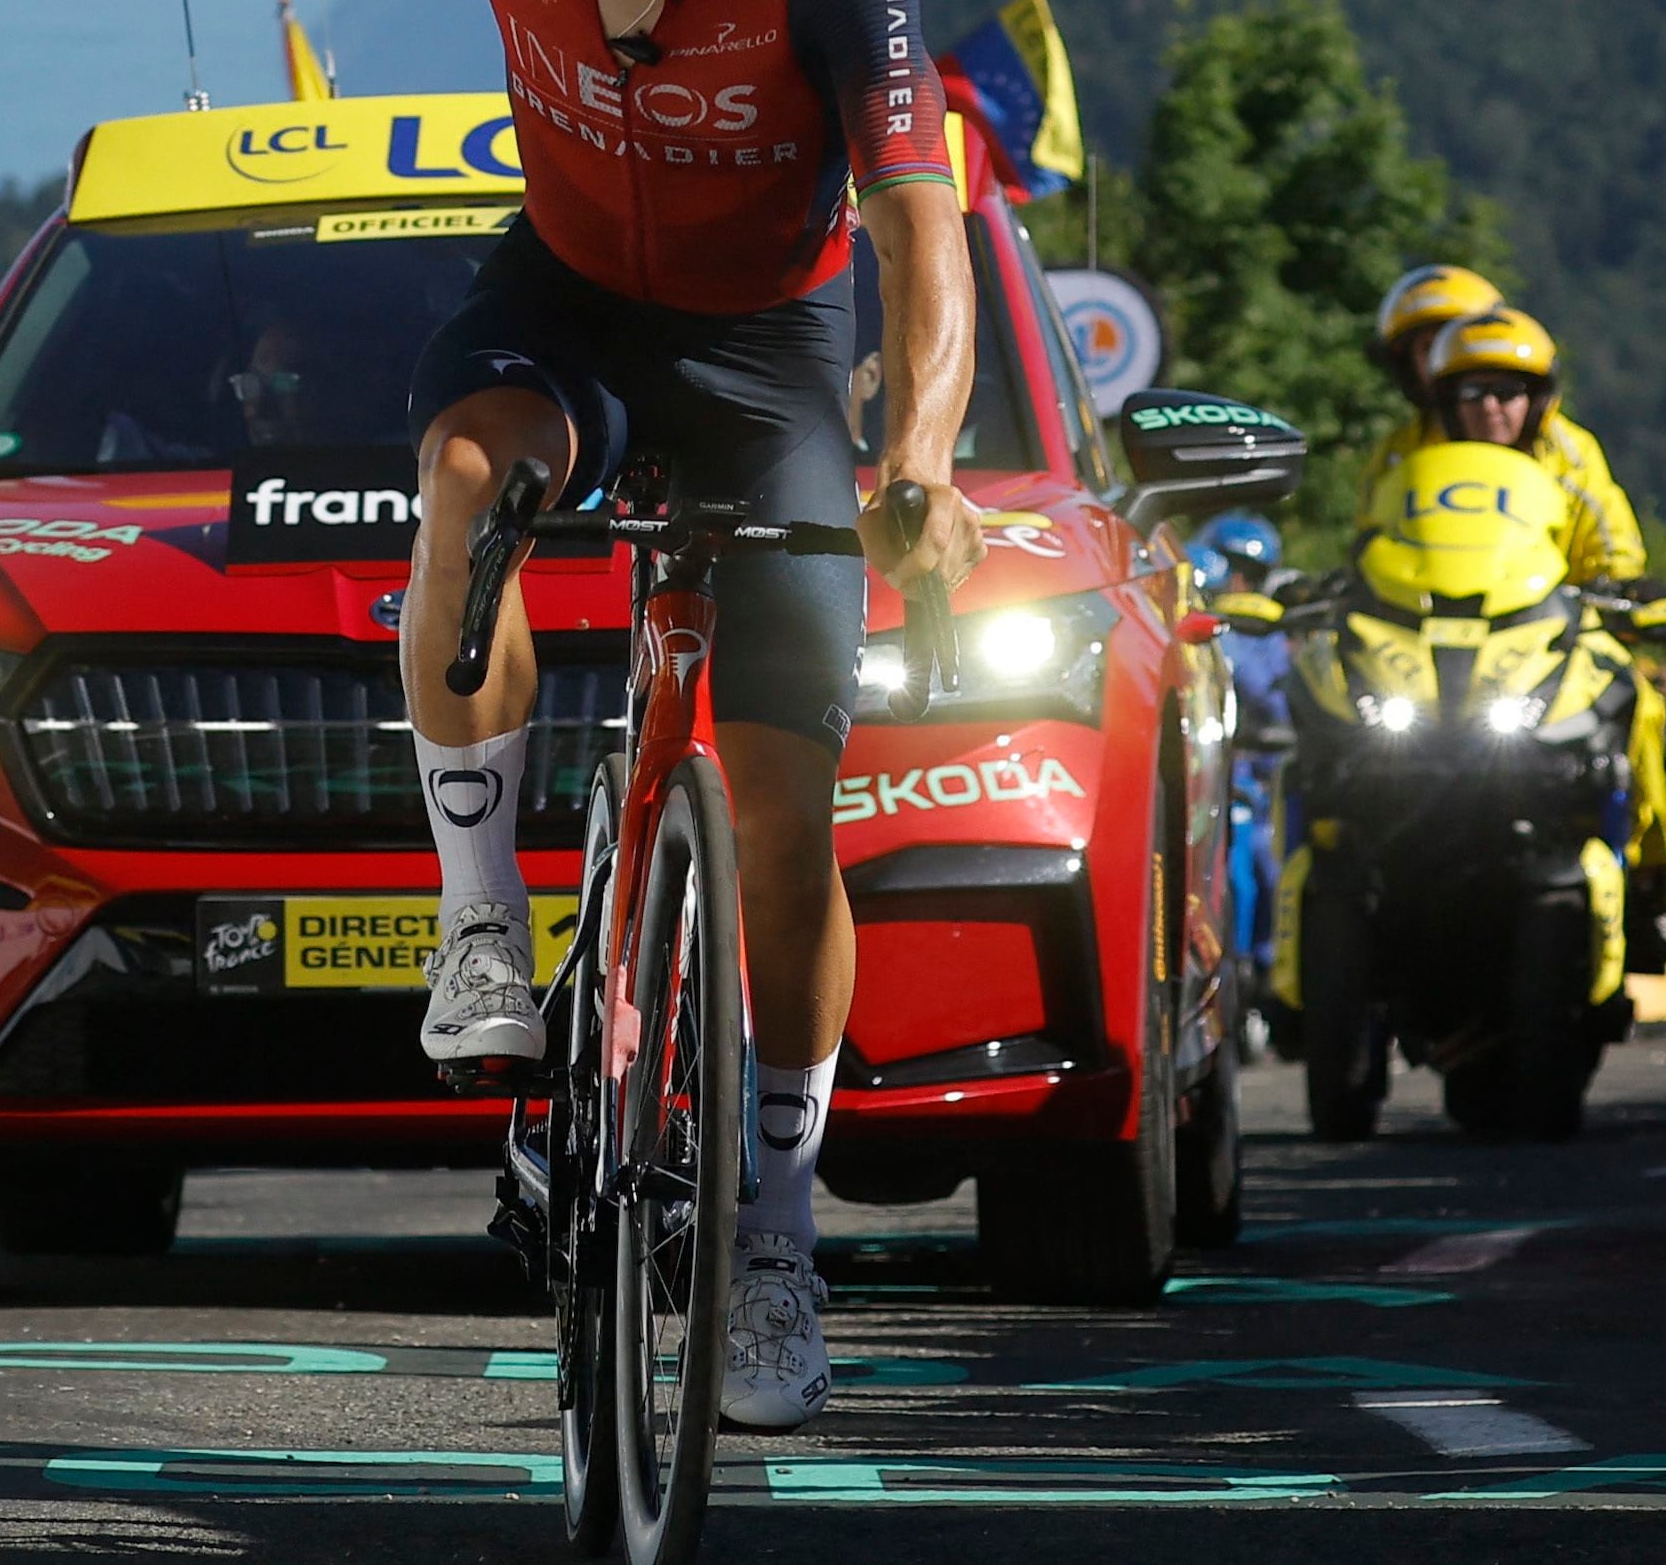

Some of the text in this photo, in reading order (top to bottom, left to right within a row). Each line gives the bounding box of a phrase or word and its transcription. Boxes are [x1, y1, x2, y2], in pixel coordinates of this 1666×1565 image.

[507, 13, 758, 132] INEOS
[239, 125, 348, 155] LCL
[333, 214, 484, 234] OFFICIEL
